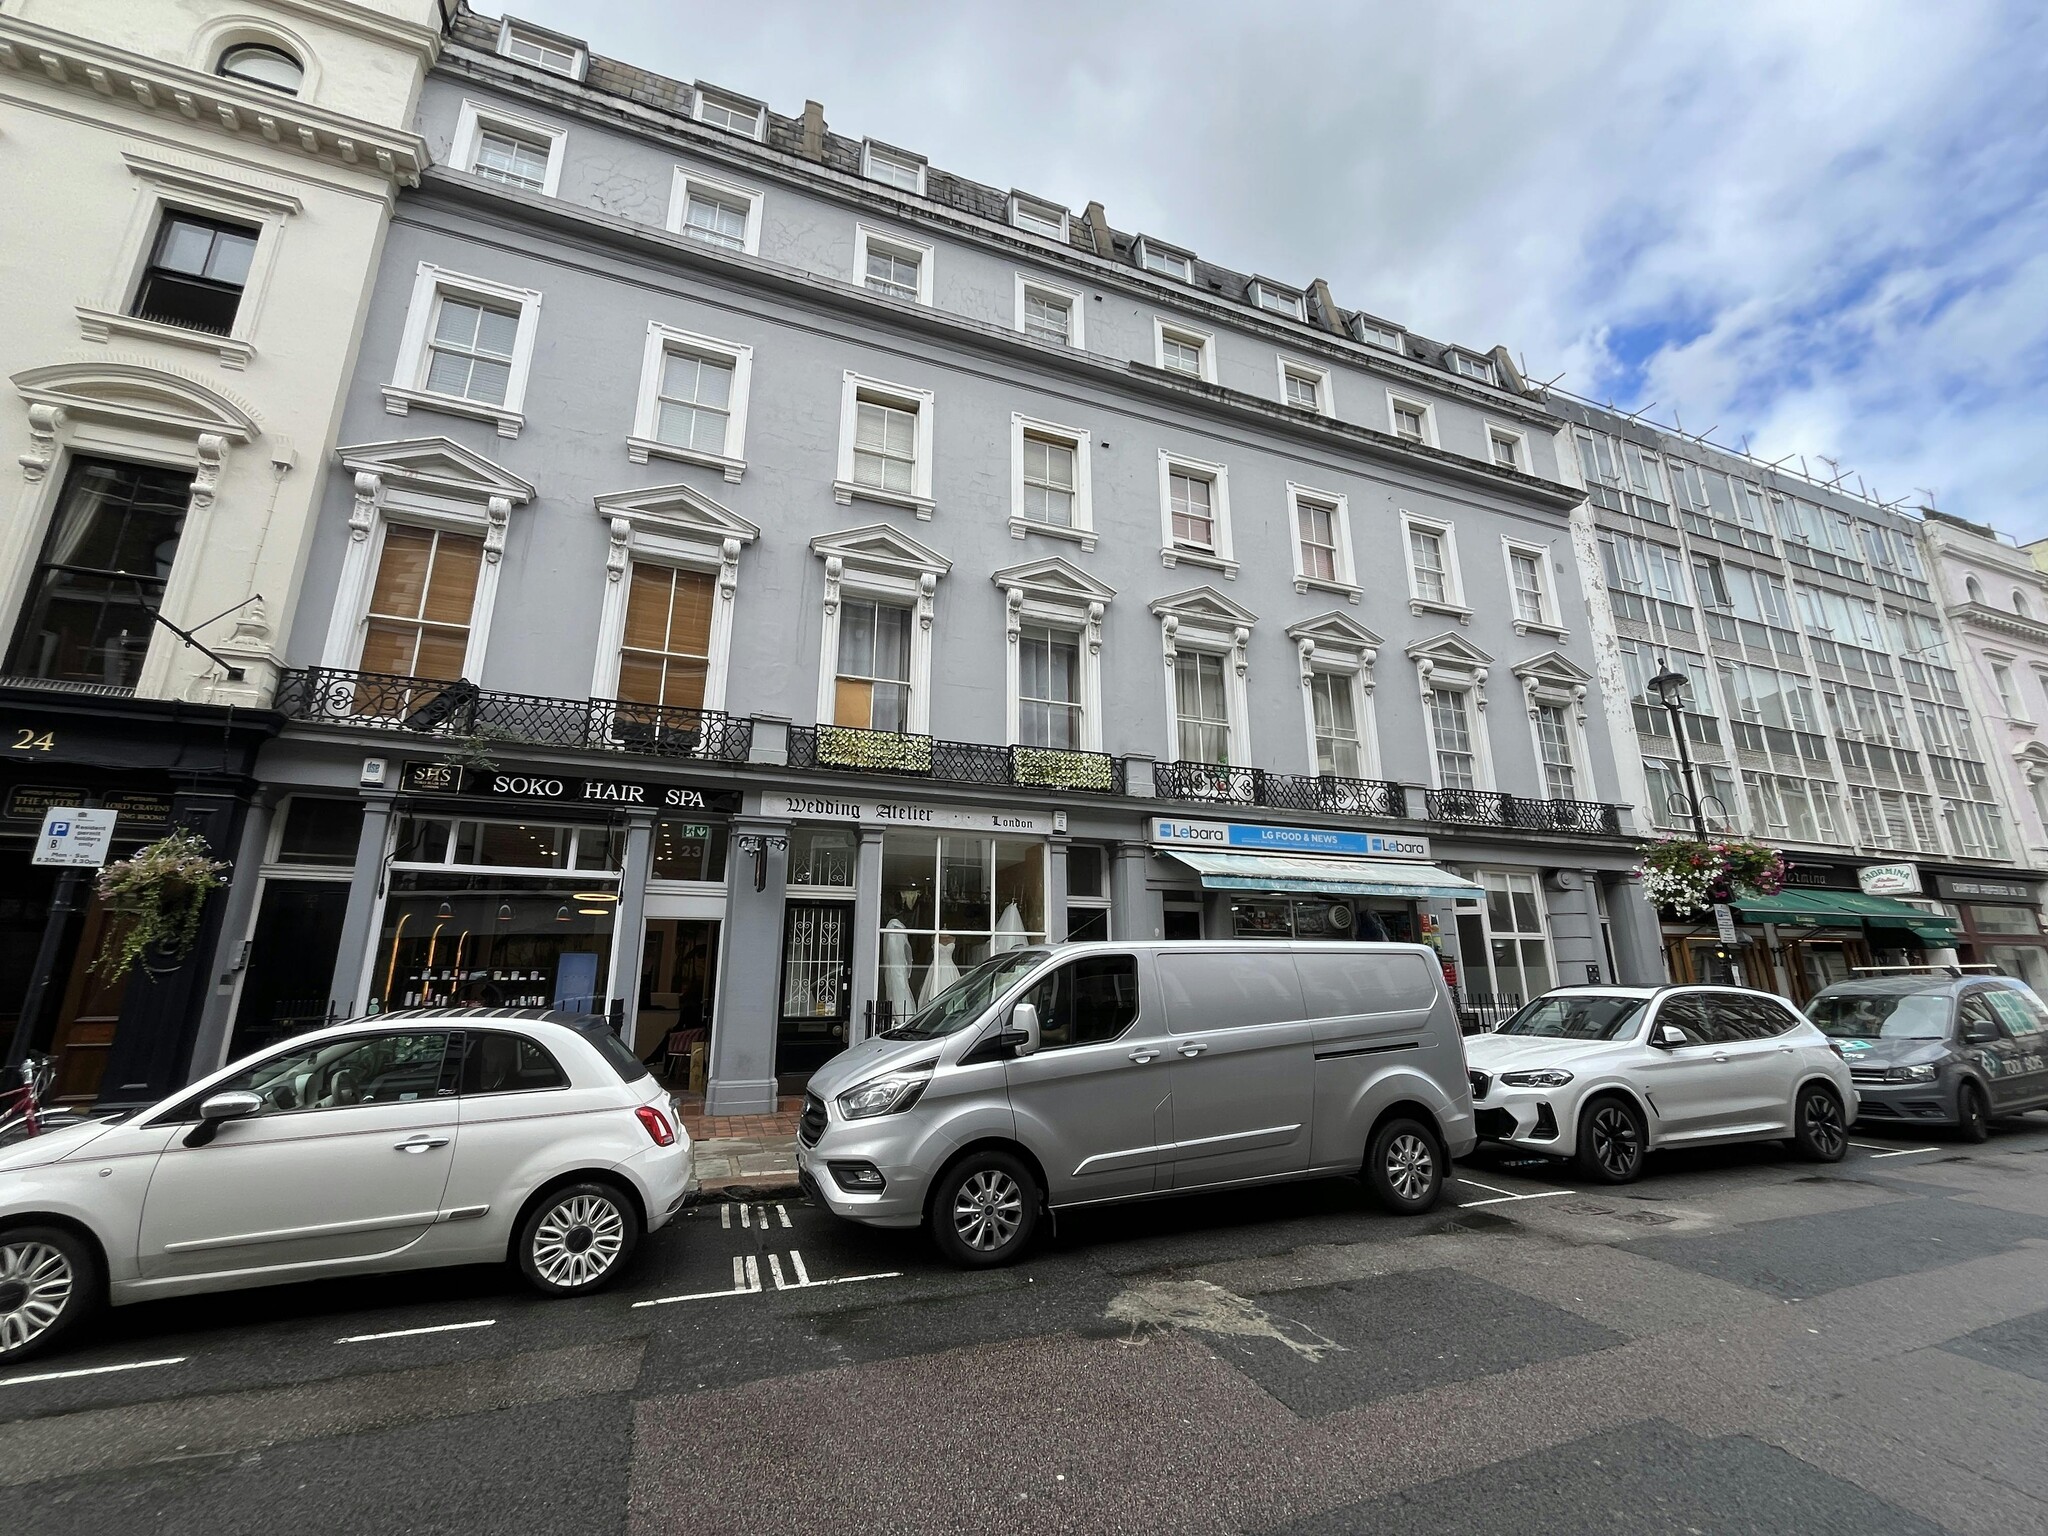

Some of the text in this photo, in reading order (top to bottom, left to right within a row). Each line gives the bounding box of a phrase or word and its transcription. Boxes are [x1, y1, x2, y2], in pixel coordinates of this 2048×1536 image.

[12, 729, 55, 751] 24
[415, 767, 451, 782] SHS
[493, 776, 705, 807] SOKO HAIR SPA
[15, 797, 81, 807] THE MITRE
[105, 802, 131, 810] LORD
[786, 797, 1033, 829] Wedding Atelier London
[52, 823, 67, 835] P
[1172, 824, 1223, 840] Lebara
[50, 840, 57, 848] B
[1261, 830, 1274, 839] LG
[1275, 831, 1301, 841] FOOD
[1303, 833, 1310, 842] &
[1311, 834, 1338, 844] NEWS
[681, 845, 701, 857] 23
[1382, 839, 1424, 854] Lebara
